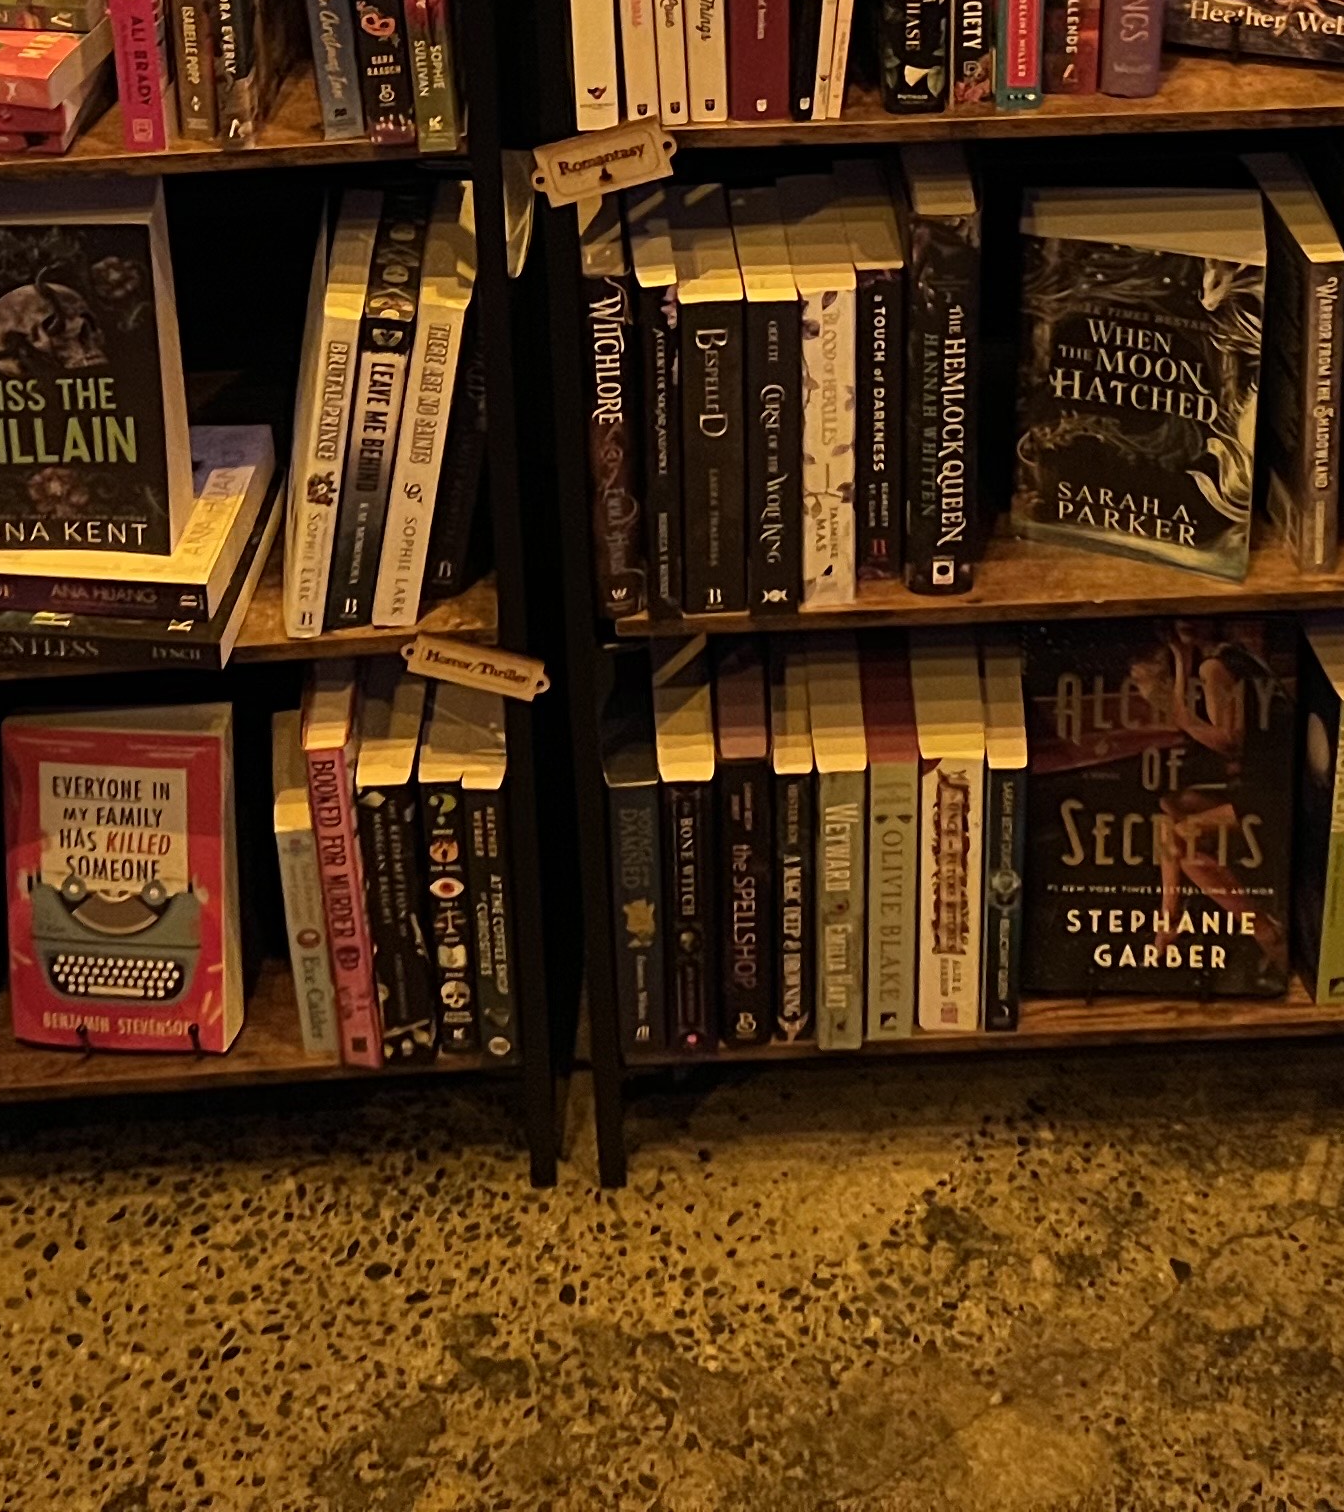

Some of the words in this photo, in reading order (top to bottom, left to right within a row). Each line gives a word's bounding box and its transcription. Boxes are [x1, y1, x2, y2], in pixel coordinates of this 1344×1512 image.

[128, 15, 143, 44] ALI
[1189, 0, 1288, 35] Heather
[129, 49, 151, 108] BRADY
[413, 40, 429, 97] SULLIVAN
[429, 44, 444, 89] SOPHIE
[557, 141, 646, 178] Romantasy
[874, 305, 887, 363] TOUCH
[948, 304, 966, 332] THE
[1088, 317, 1173, 355] WHEN
[324, 341, 350, 402] BRUTAL
[588, 295, 625, 426] WITCHLORE
[874, 368, 884, 385] of
[923, 332, 940, 418] HANNAH
[1058, 343, 1092, 363] THE
[1094, 347, 1206, 395] MOON
[55, 378, 117, 411] THE
[366, 361, 395, 406] LEAVE
[942, 336, 967, 454] HEMLOCK
[1049, 366, 1219, 425] HATCHED
[315, 405, 341, 460] PRINCE
[363, 410, 390, 433] ME
[872, 387, 886, 472] DARKNESS
[355, 435, 387, 492] BEHIND
[920, 425, 937, 518] WHITTEN
[936, 456, 968, 548] QUEEN
[1058, 480, 1160, 517] SARAH
[1172, 503, 1197, 525] A.
[1058, 499, 1197, 548] PARKER
[64, 521, 148, 546] KENT
[397, 515, 419, 571] SOPHIE
[390, 577, 410, 617] LARK
[425, 649, 530, 685] Horror/Thriller
[52, 776, 142, 801] EVERYONE
[152, 781, 170, 801] IN
[1141, 747, 1186, 790] OF
[63, 807, 89, 822] MY
[95, 807, 163, 828] FAMILY
[312, 760, 344, 830] BOOKED
[59, 827, 97, 852] HAS
[106, 831, 171, 856] KILLED
[323, 834, 347, 867] FOR
[679, 816, 695, 862] BONE
[731, 844, 749, 873] the
[65, 855, 160, 881] SOMEONE
[679, 864, 695, 917] WITCH
[880, 829, 904, 915] OLIVIE
[327, 875, 356, 939] MURDER
[1066, 908, 1256, 935] STEPHANIE
[732, 875, 756, 988] SPELLSHOP
[878, 924, 902, 1003] BLAKE
[1093, 943, 1227, 969] GARBER
